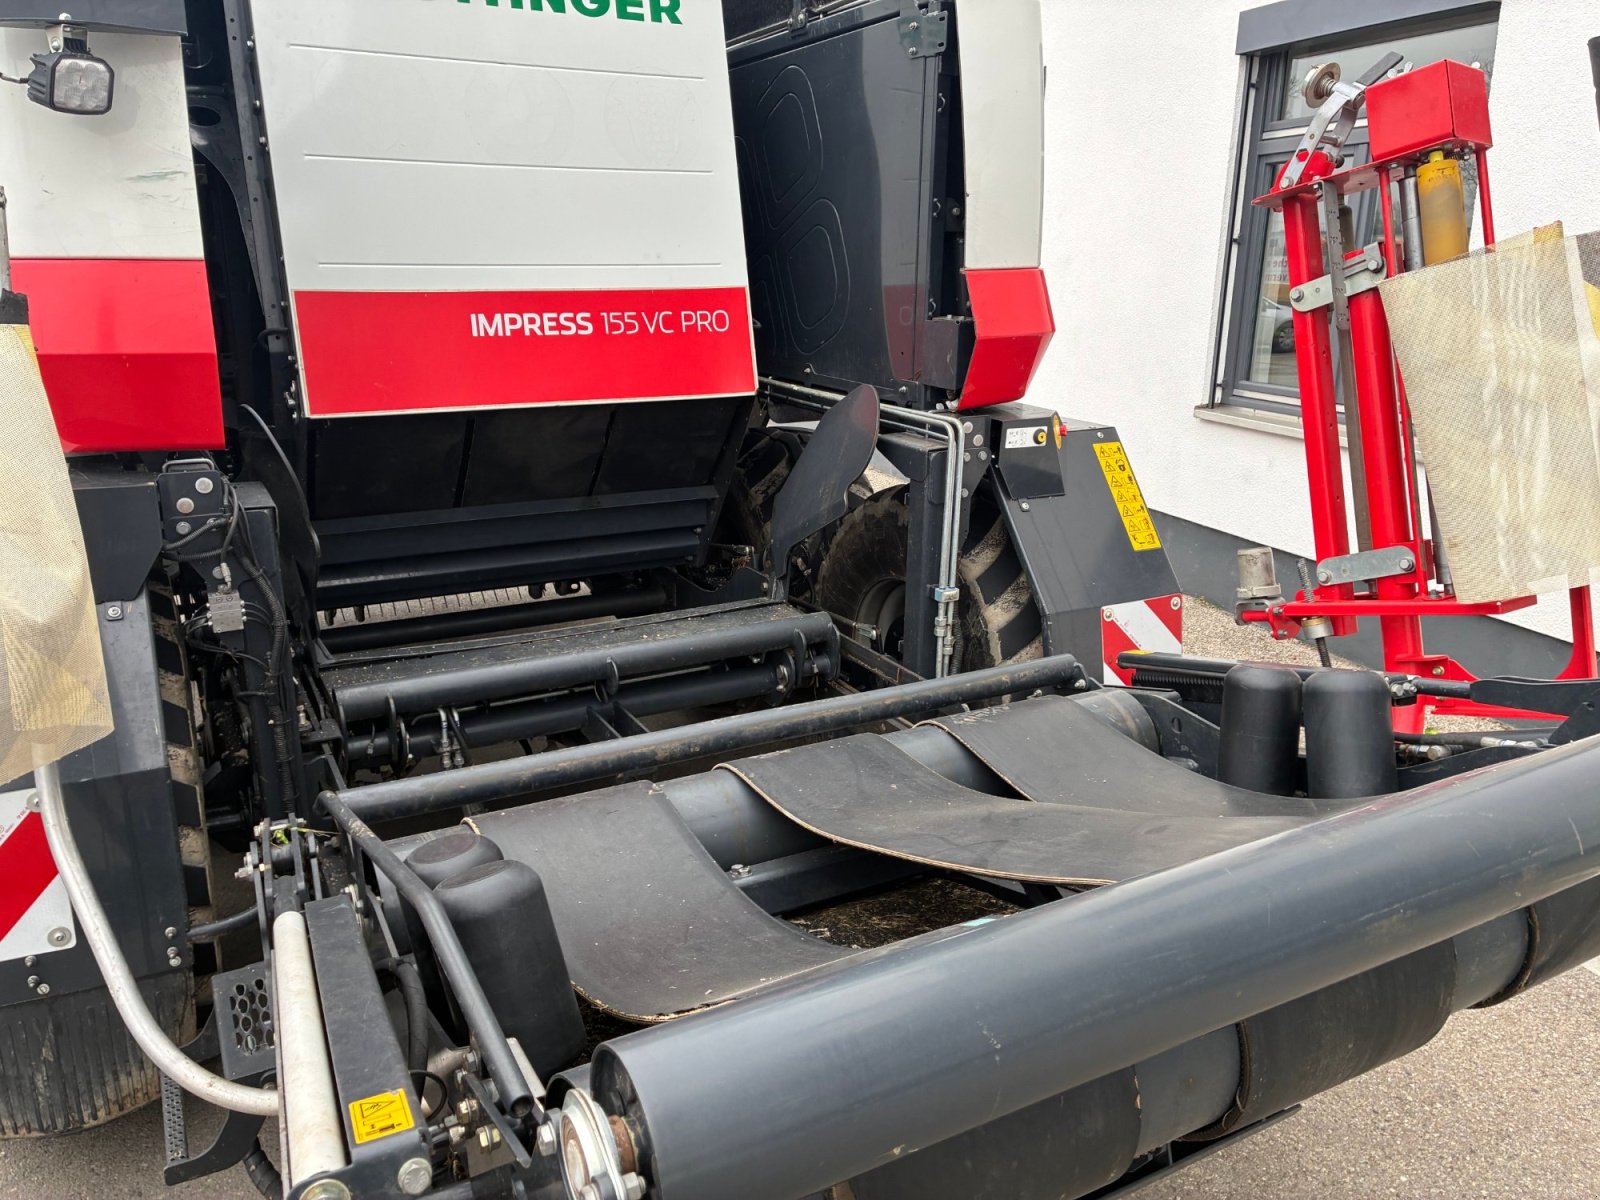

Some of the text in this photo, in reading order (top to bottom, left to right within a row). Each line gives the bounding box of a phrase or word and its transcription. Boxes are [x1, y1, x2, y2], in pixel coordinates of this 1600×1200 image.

[470, 309, 730, 337] IMPRESS 155 VC PRO
